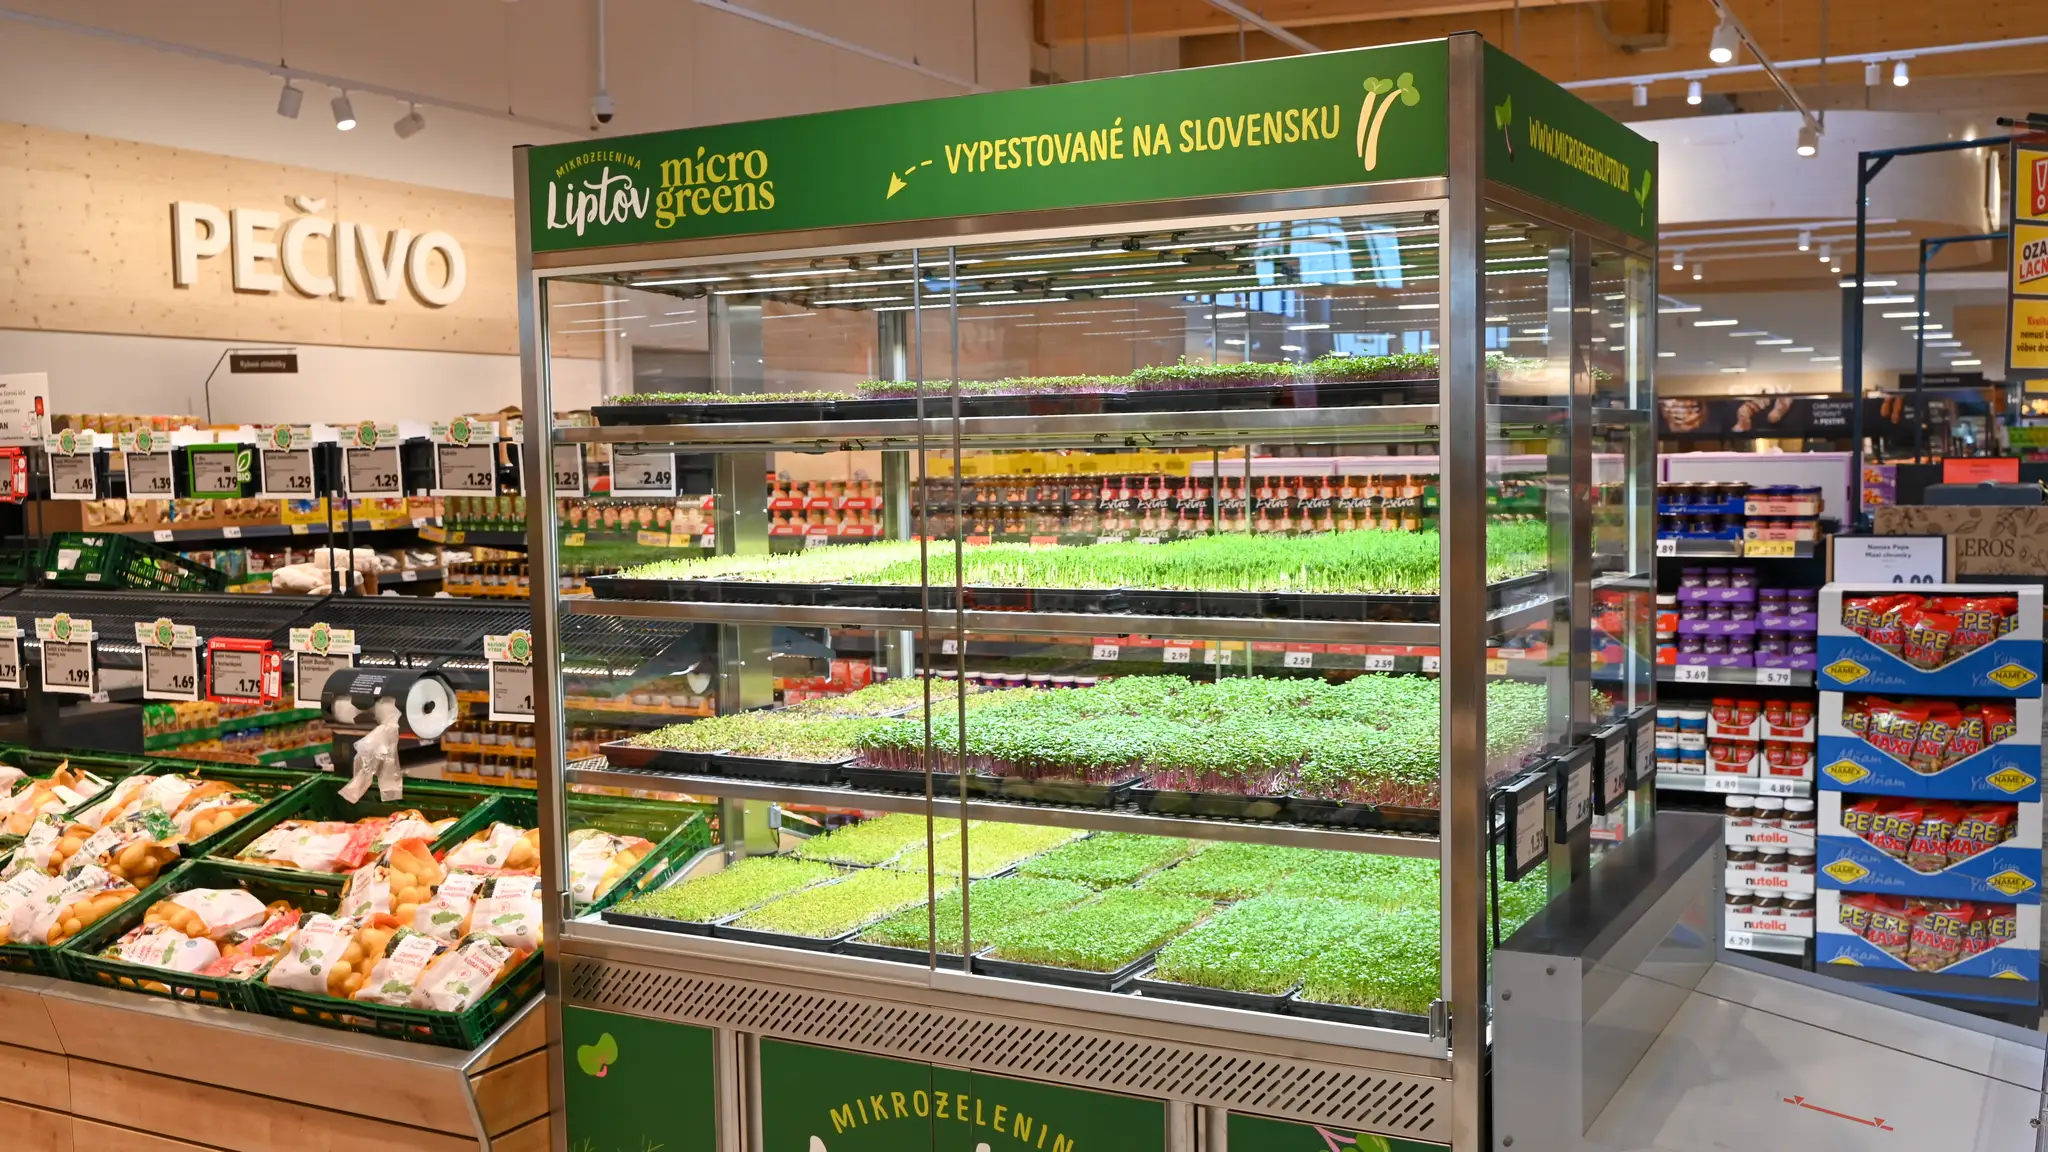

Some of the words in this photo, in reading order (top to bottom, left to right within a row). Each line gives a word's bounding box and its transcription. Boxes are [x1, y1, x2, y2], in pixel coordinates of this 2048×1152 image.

[944, 117, 1124, 174] VYPESTOVANÉ
[1133, 124, 1172, 157] NA
[1179, 104, 1341, 153] SLOVENSKU
[555, 151, 642, 178] MIKROZELENINA
[547, 166, 650, 236] Liptov
[655, 180, 775, 229] greens
[172, 195, 467, 306] PEČIVO
[217, 476, 238, 489] 1.79
[237, 473, 250, 481] BIO
[289, 476, 311, 488] 1.29
[375, 474, 399, 487] 1.29
[468, 473, 492, 486] 1.29
[643, 472, 671, 485] 2.49
[75, 478, 93, 490] 1.49
[152, 478, 171, 490] 1.39
[69, 669, 90, 682] 1.99
[1685, 669, 1706, 679] 3.69
[1767, 673, 1789, 683] 5.79
[1995, 671, 2028, 681] NAMEX
[173, 675, 194, 689] 1.69
[239, 678, 261, 692] 1.79
[1994, 775, 2026, 785] NAMEX
[1770, 783, 1792, 793] 4.89
[1745, 832, 1789, 844] nutella
[1745, 875, 1788, 888] nutella
[1994, 877, 2026, 887] NAMEX
[1744, 919, 1788, 931] nutella
[1728, 936, 1750, 946] 6.29
